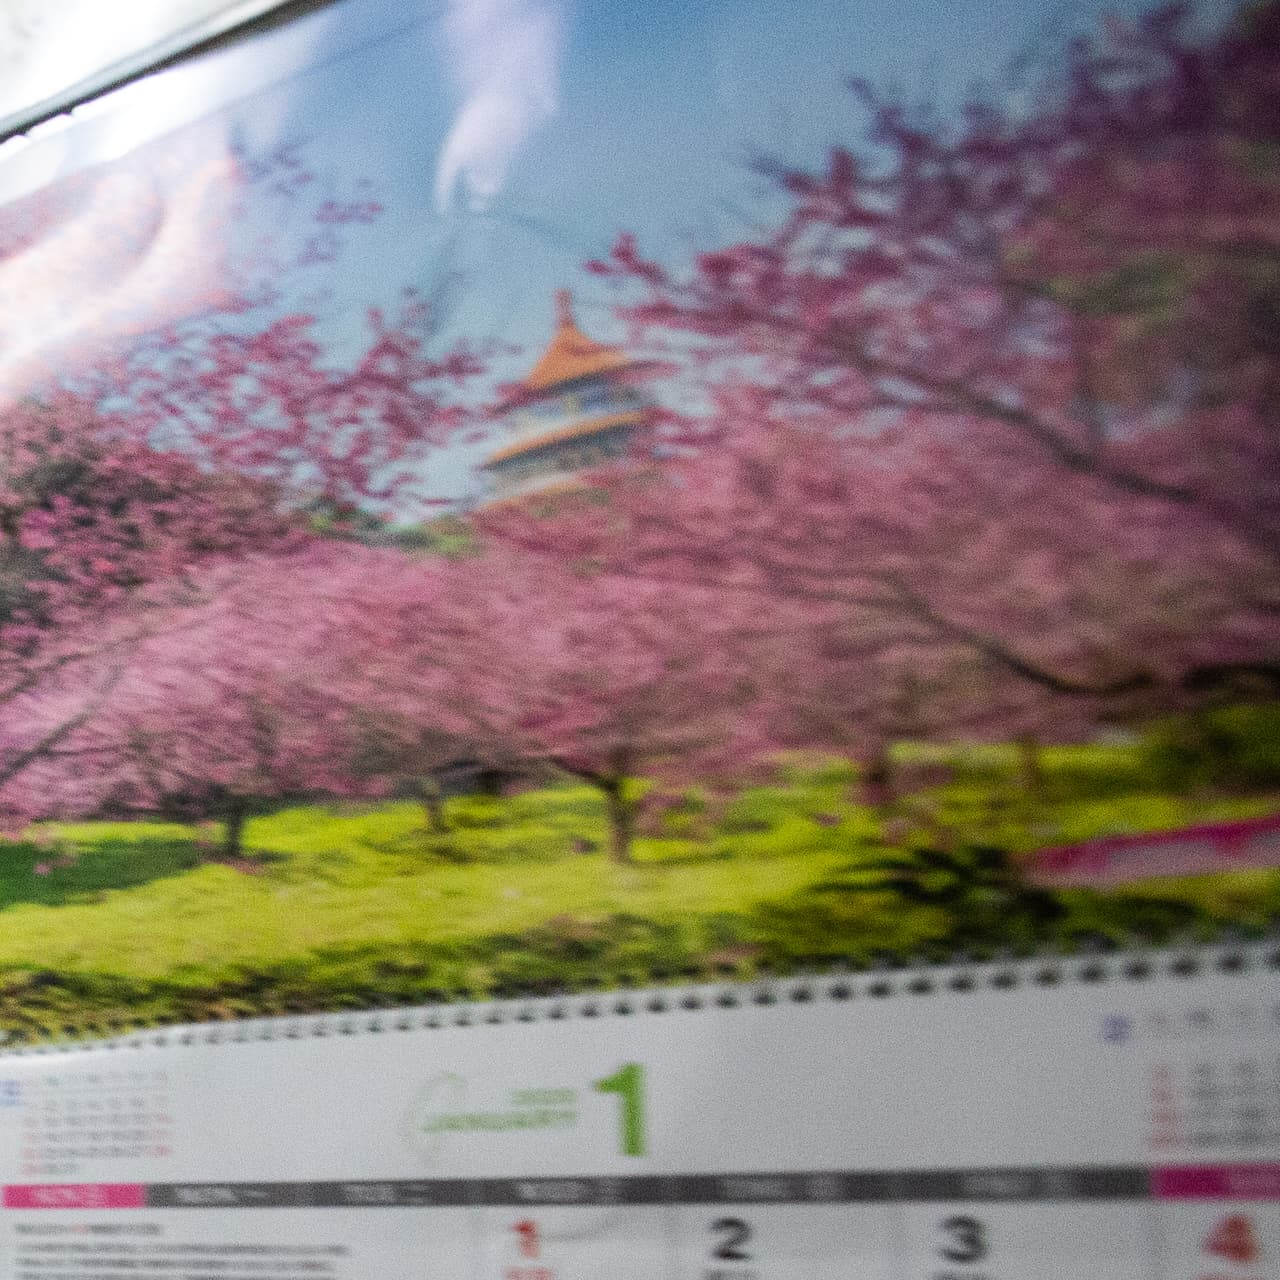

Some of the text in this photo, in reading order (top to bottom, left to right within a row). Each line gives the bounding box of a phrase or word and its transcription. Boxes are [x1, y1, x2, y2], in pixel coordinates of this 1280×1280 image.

[593, 1062, 647, 1157] 1
[511, 1213, 1260, 1265] 1 2 3 4
